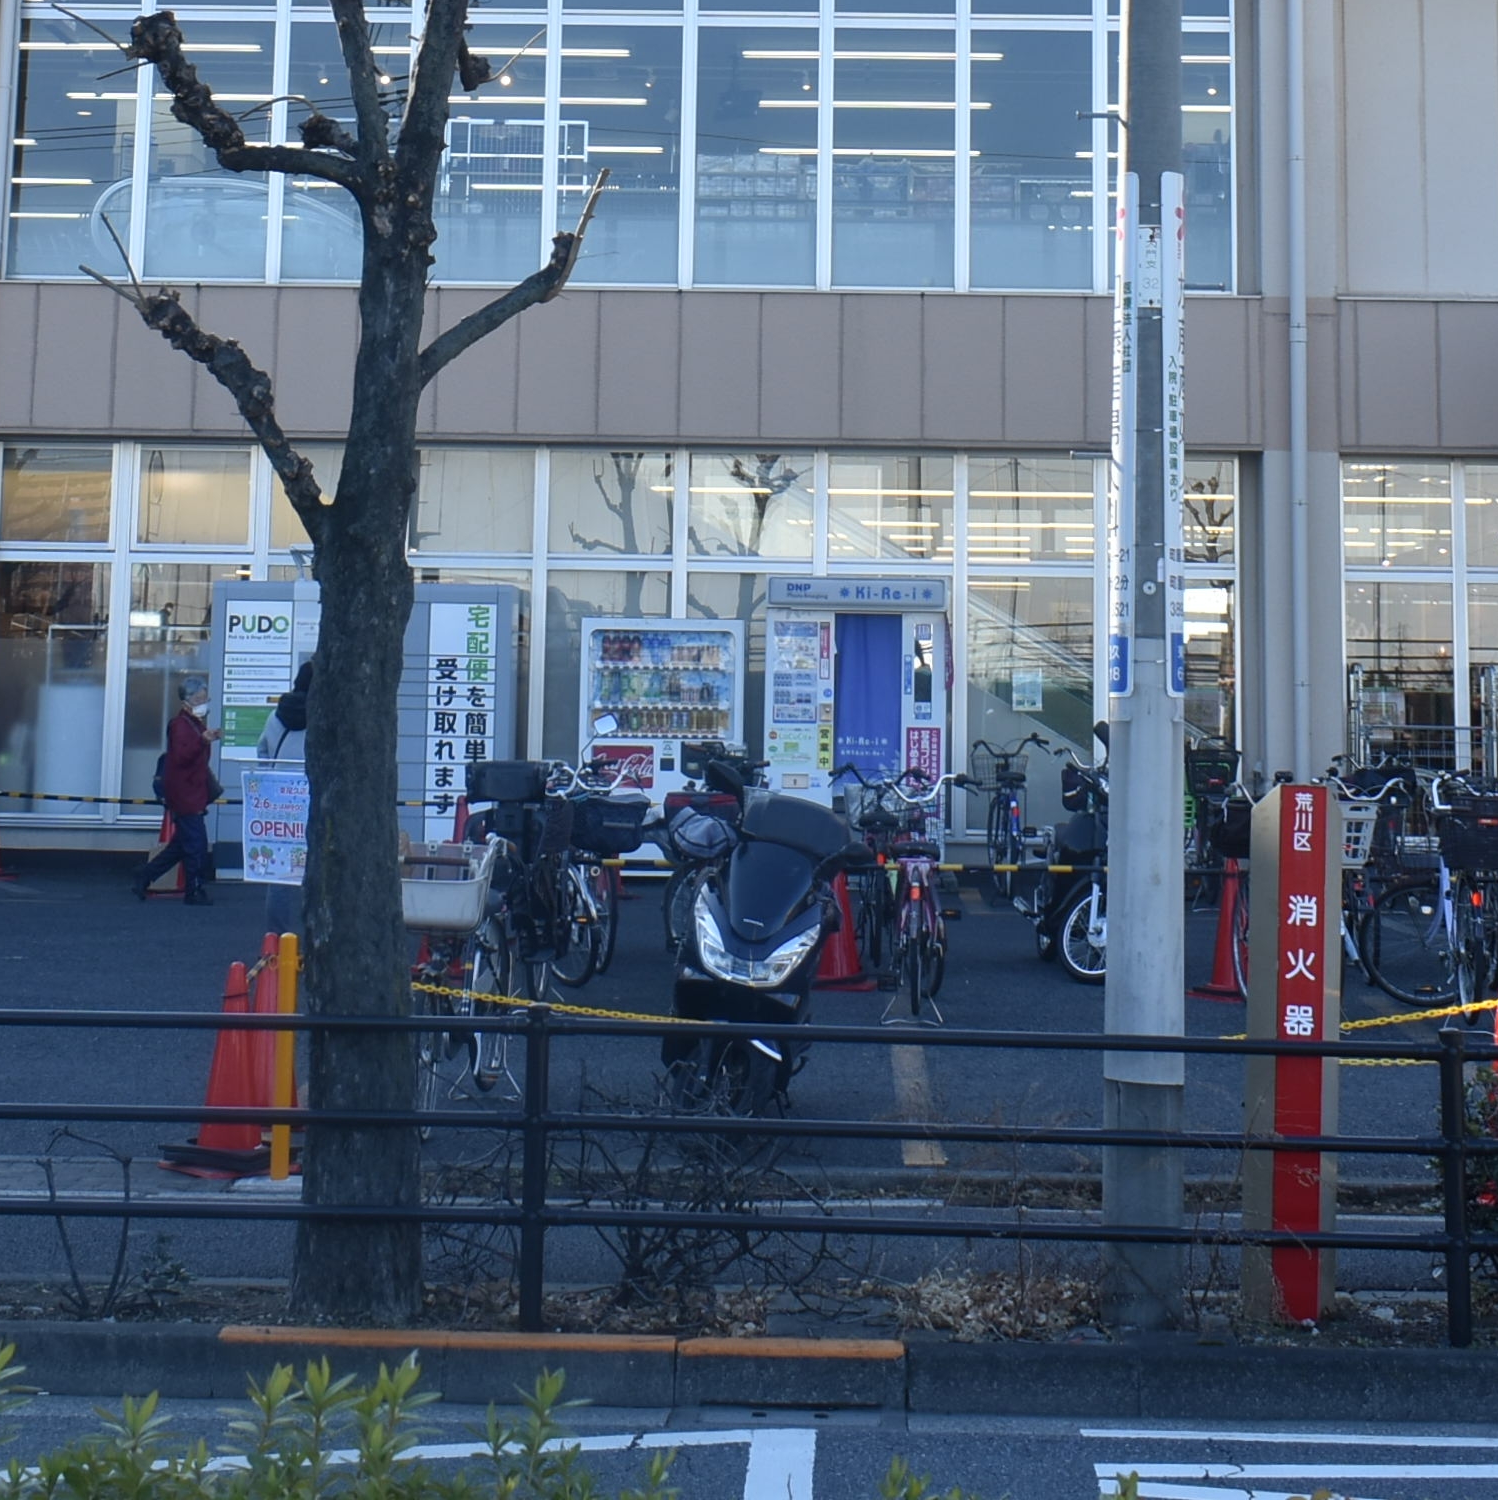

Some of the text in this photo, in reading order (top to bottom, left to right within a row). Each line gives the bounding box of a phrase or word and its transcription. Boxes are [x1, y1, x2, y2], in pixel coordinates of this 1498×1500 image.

[1142, 277, 1159, 290] 32
[787, 583, 811, 591] DNP
[855, 586, 917, 600] Ki-Re-i
[229, 614, 289, 633] PUDO
[434, 658, 458, 815] 受け取れます
[251, 820, 304, 838] OPEN!!
[1294, 792, 1314, 852] 荒川区
[1284, 895, 1318, 1036] 消火器
